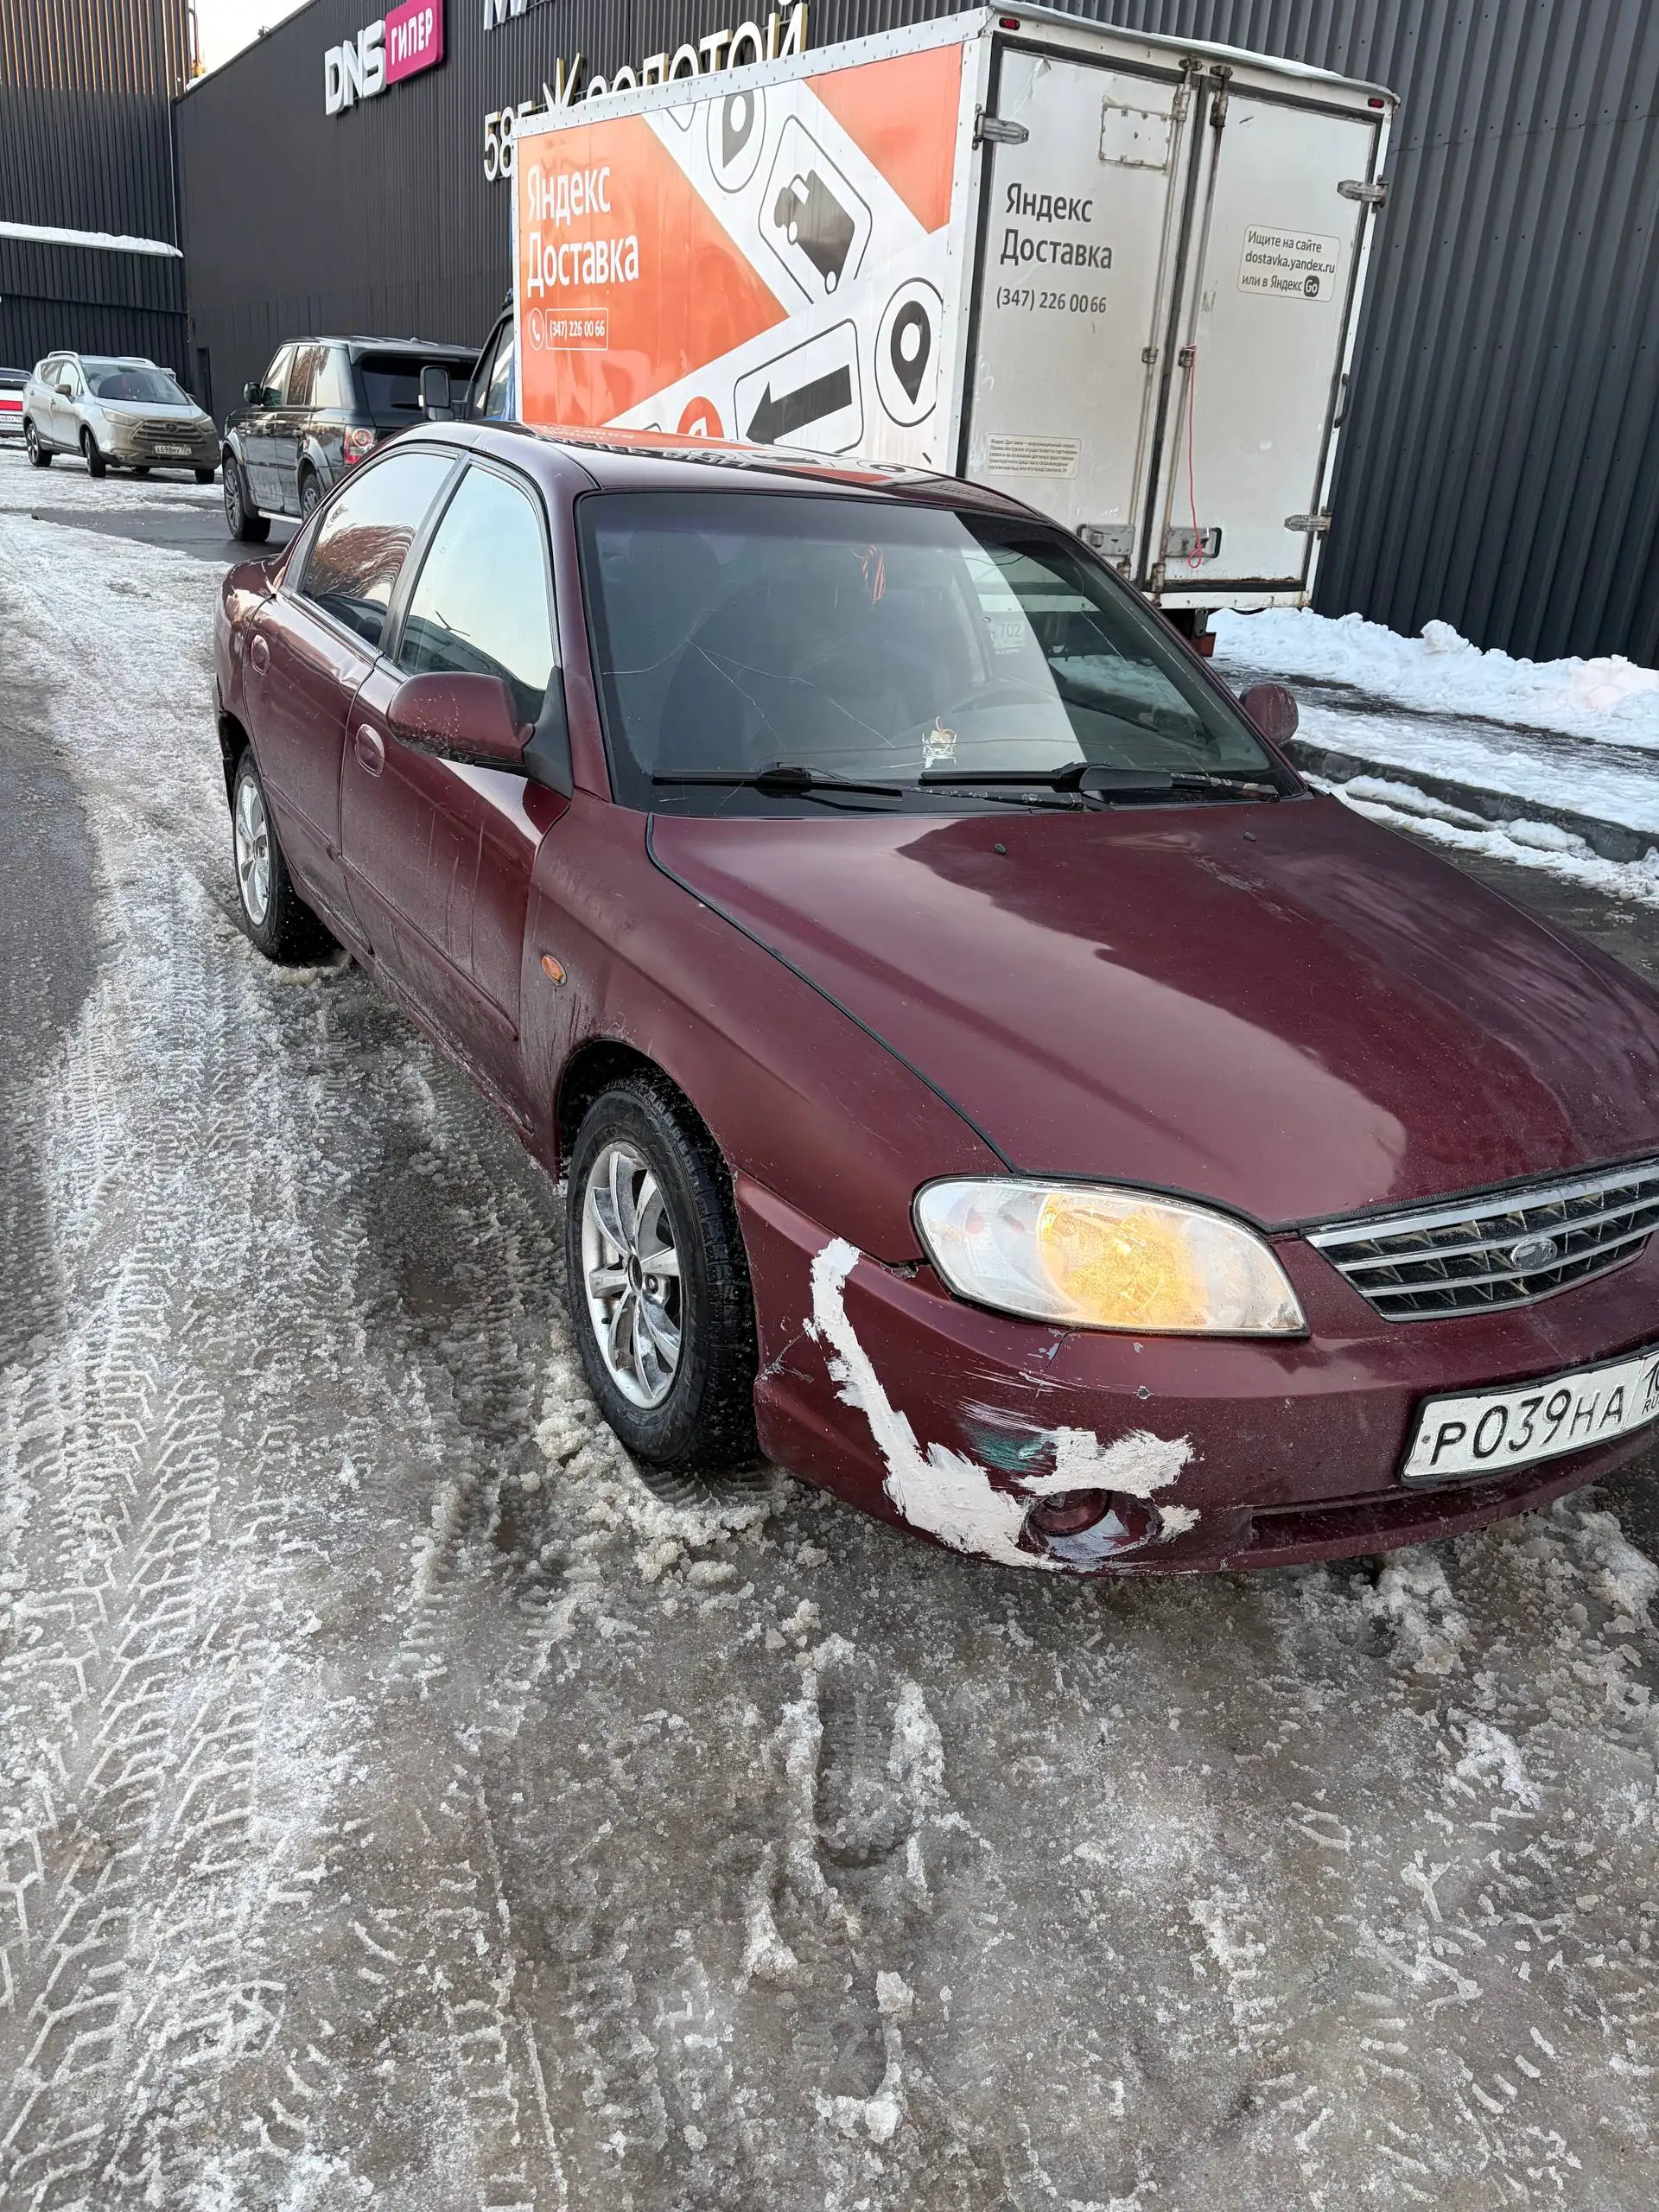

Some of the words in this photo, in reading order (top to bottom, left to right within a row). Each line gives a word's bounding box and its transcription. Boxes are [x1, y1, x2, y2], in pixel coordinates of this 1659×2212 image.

[391, 7, 433, 66] ГИПЕР
[325, 19, 386, 115] DNS
[527, 165, 611, 226] Яндекс
[1006, 182, 1093, 223] Яндекс
[1000, 228, 1112, 270] Доставка
[1245, 251, 1335, 273] dostavka.yandex.ru
[1248, 231, 1281, 247] Ищите
[1282, 238, 1294, 249] на
[1296, 239, 1322, 252] сайте
[527, 232, 639, 297] Доставка
[1242, 275, 1261, 287] или
[1262, 277, 1268, 287] в
[1270, 275, 1303, 292] Яндекс
[1305, 278, 1319, 295] Go
[996, 286, 1035, 311] (347)
[1039, 291, 1065, 310] 226
[550, 319, 568, 340] (347)
[569, 321, 582, 337] 226
[584, 321, 594, 337] 00
[594, 321, 605, 337] 66
[1642, 1393, 1659, 1415] RU
[1429, 1384, 1624, 1466] Р039НА
